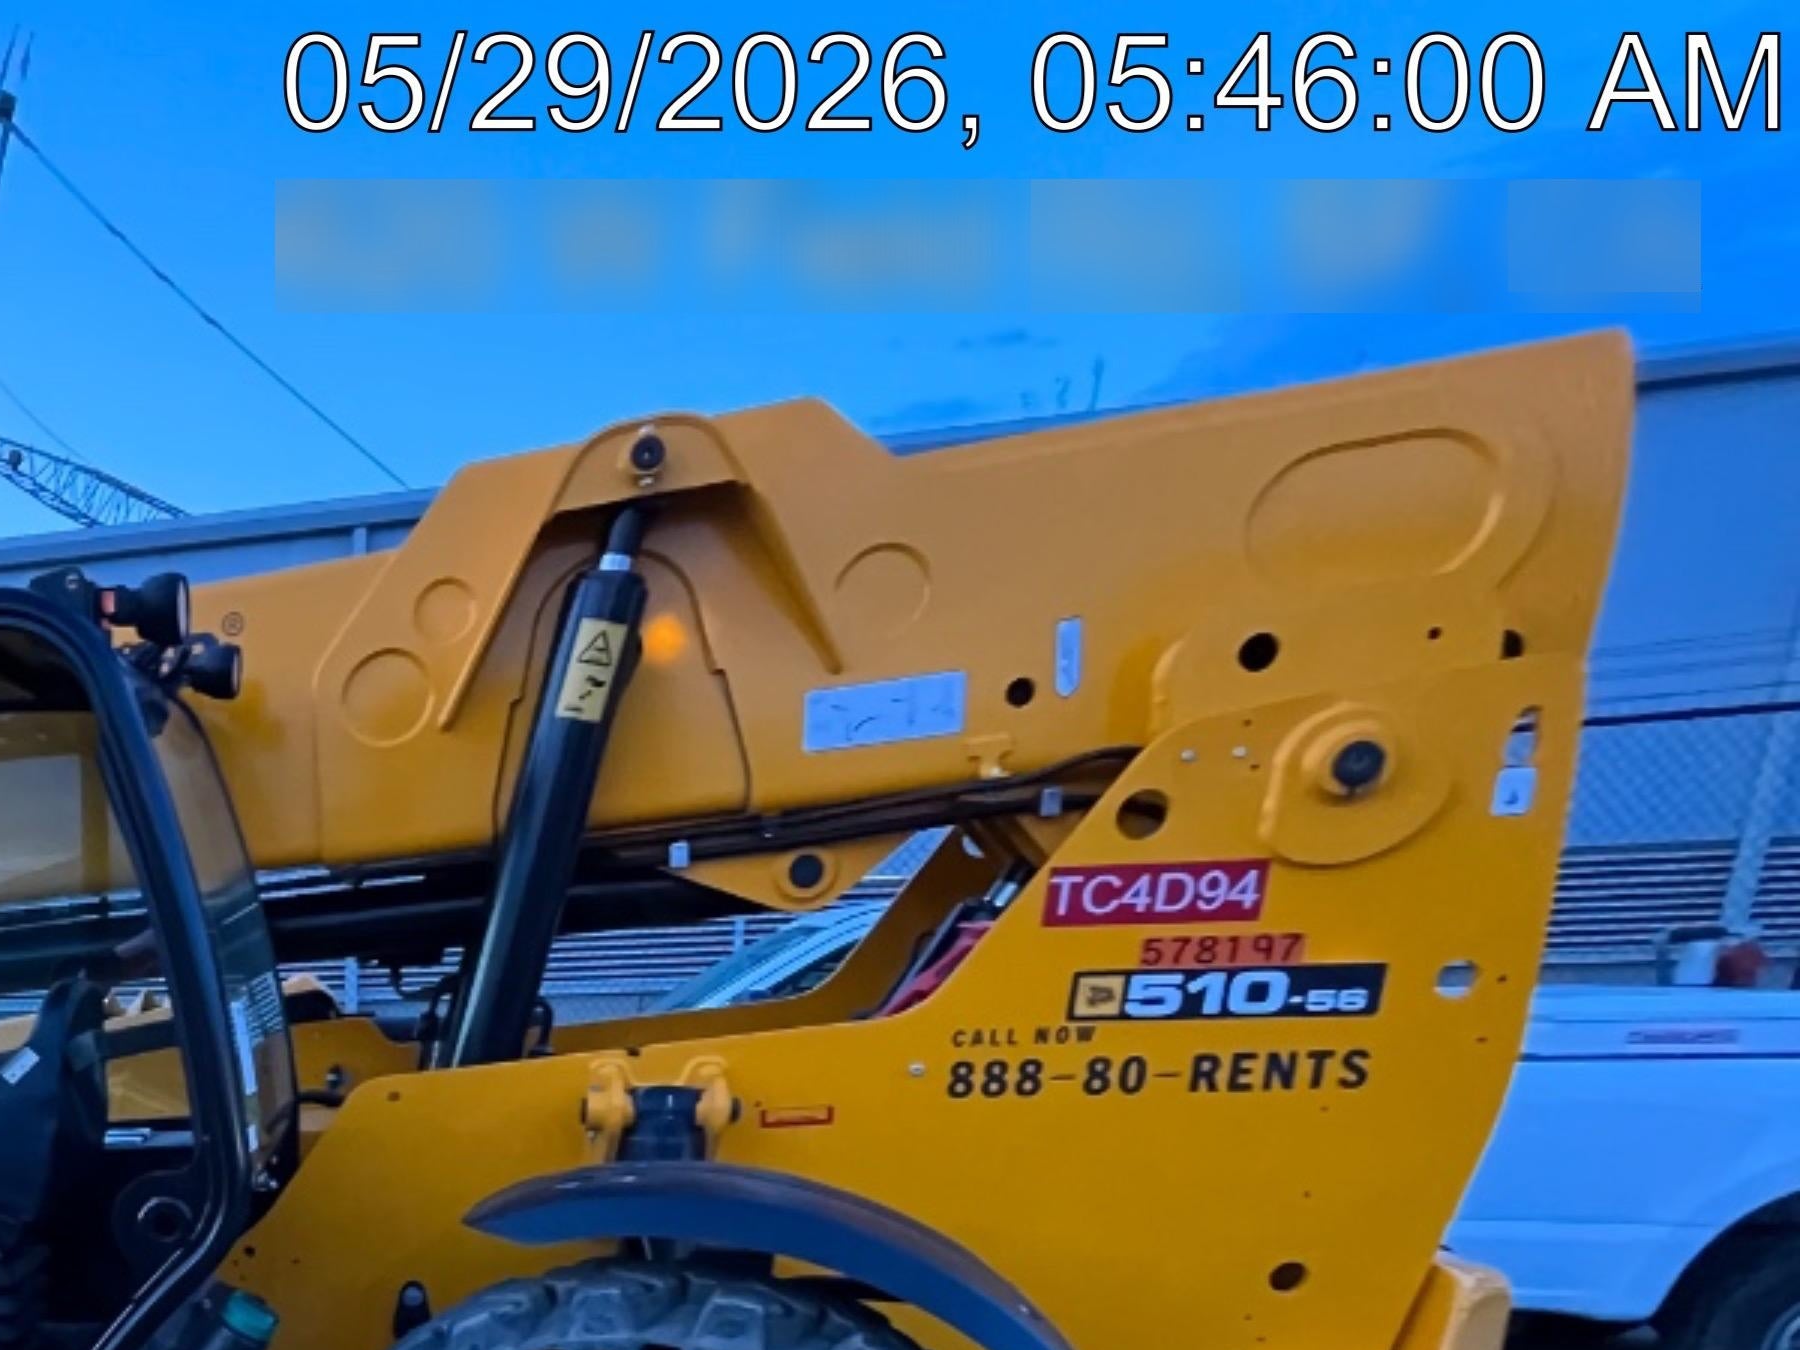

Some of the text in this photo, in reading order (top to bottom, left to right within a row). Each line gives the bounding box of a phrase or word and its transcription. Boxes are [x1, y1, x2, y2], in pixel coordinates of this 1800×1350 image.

[1049, 868, 1262, 917] TC4D94
[1141, 934, 1302, 967] 578197
[951, 1025, 1097, 1048] CALL NOW
[947, 1049, 1372, 1099] 888-80-RENTS
